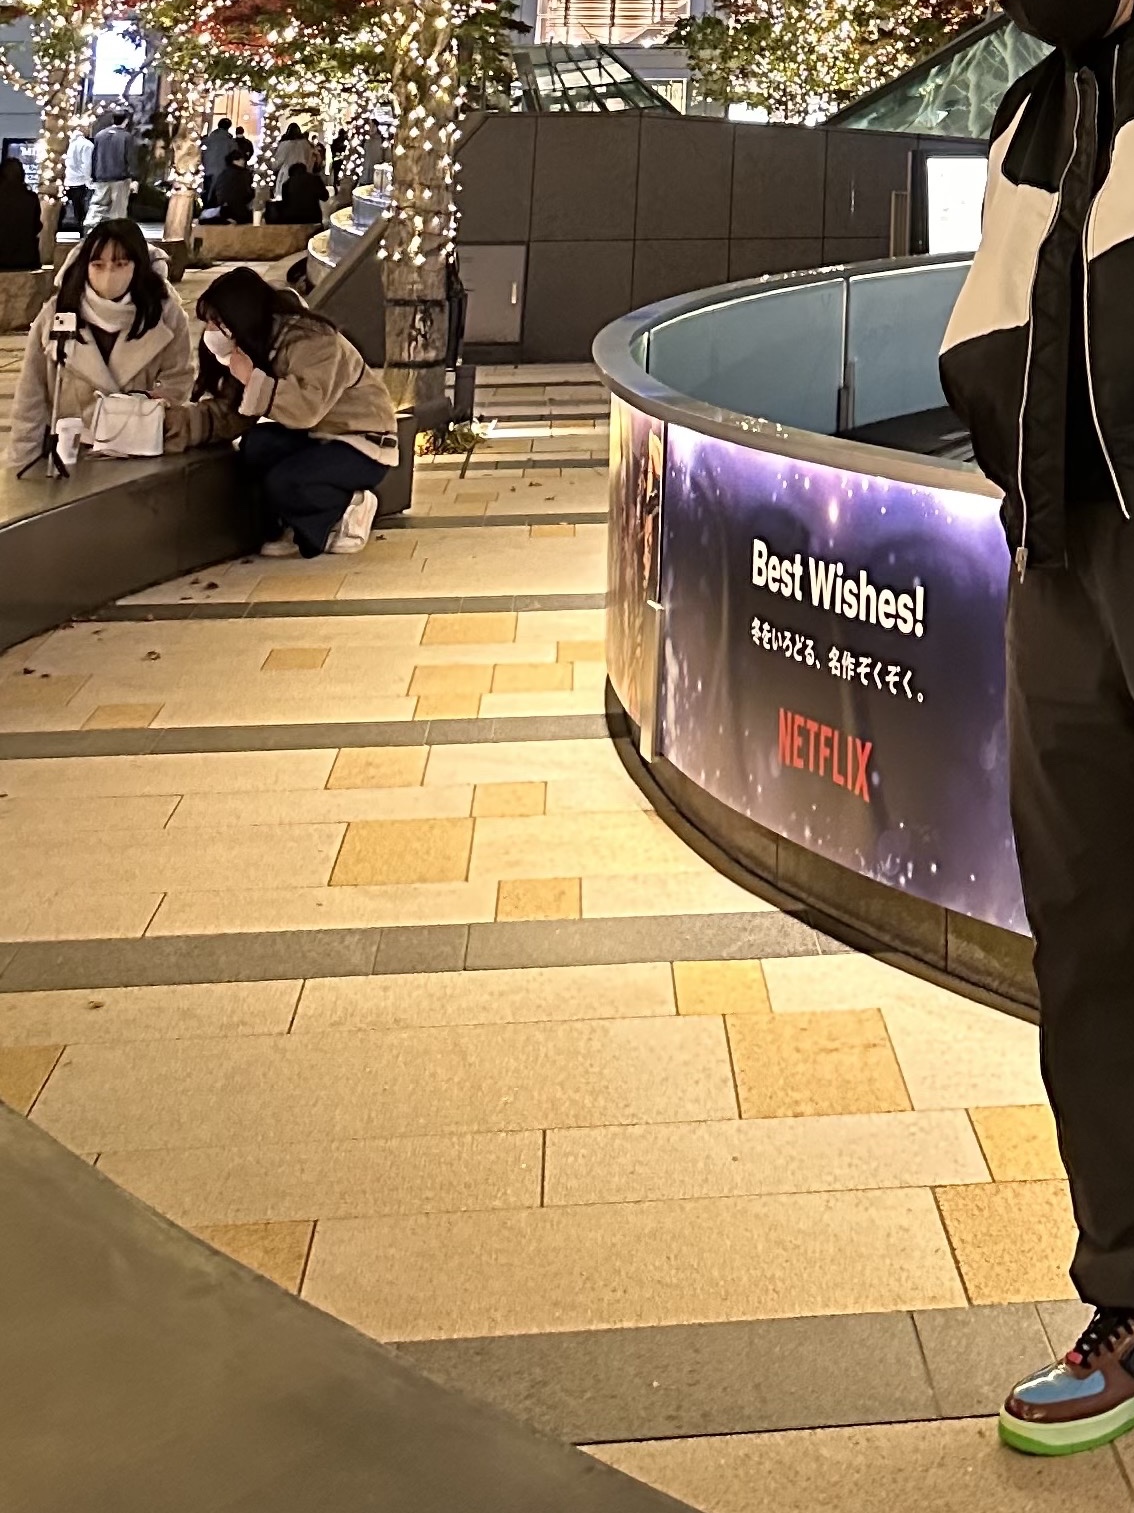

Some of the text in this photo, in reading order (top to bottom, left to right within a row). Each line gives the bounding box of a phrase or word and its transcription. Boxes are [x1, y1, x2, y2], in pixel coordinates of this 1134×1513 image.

[752, 538, 925, 637] Best Wishes!
[778, 707, 873, 803] NETFLIX
